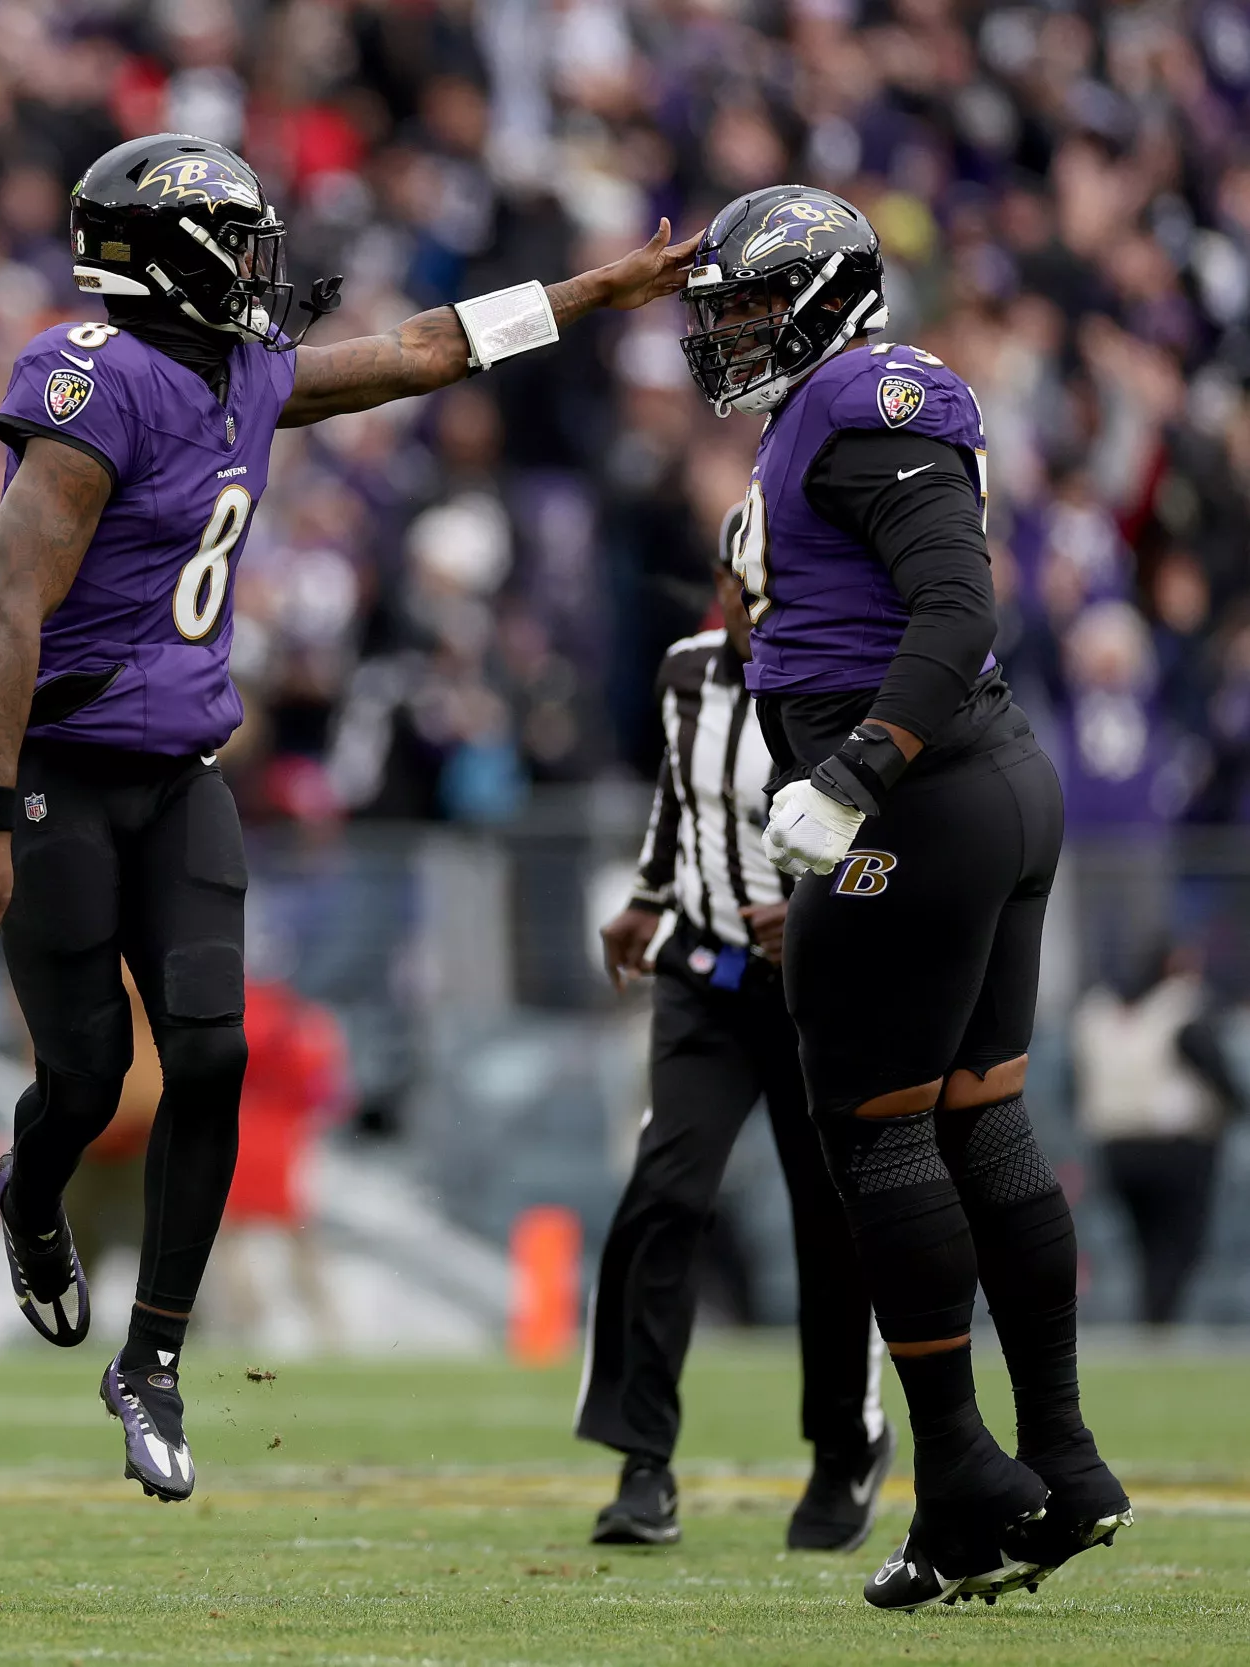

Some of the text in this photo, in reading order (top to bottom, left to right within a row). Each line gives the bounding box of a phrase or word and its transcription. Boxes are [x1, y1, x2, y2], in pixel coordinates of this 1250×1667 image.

[165, 160, 209, 186] B
[774, 202, 826, 222] B
[76, 229, 86, 255] 8
[67, 322, 120, 350] 8
[55, 373, 89, 388] RAVENS
[885, 380, 920, 394] RAVENS
[216, 466, 247, 479] RAVENS
[172, 484, 252, 641] 8
[29, 805, 44, 817] NFL
[836, 849, 898, 896] B
